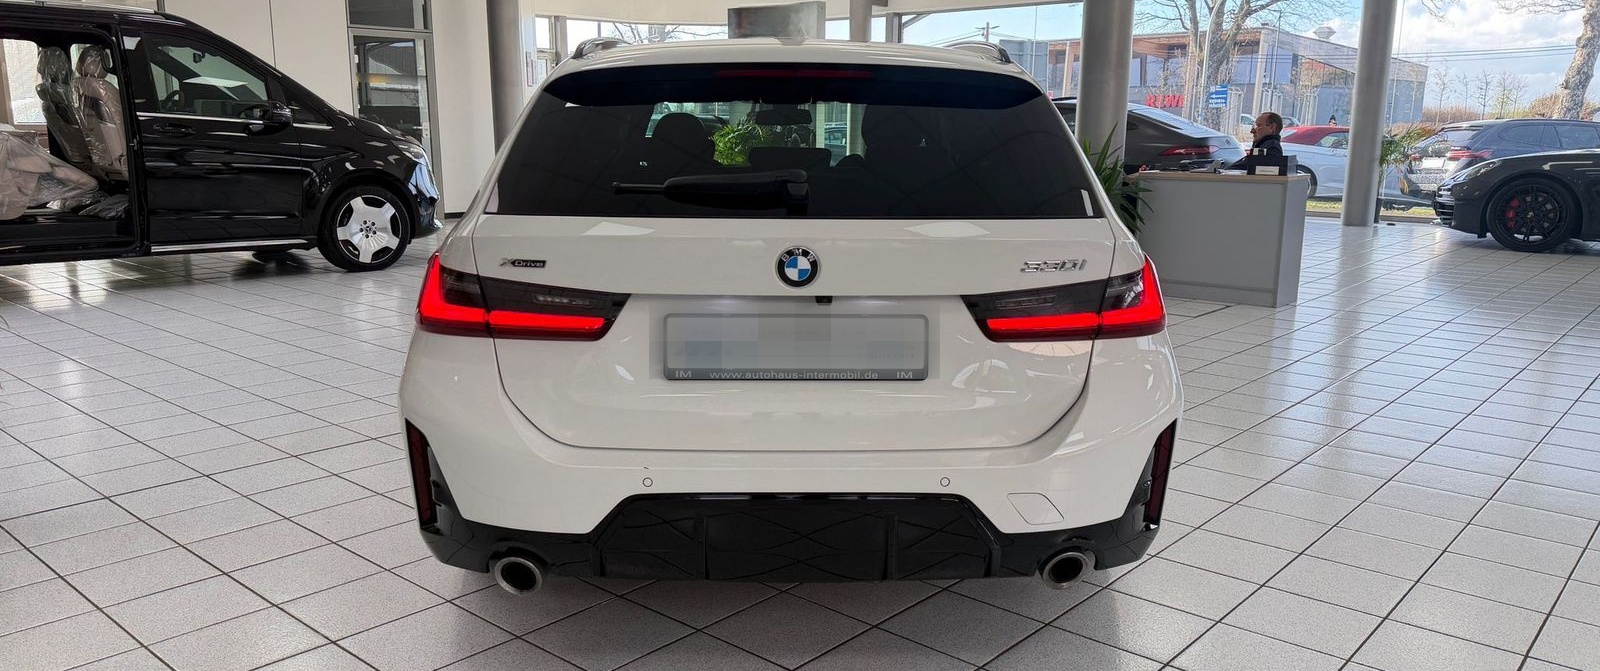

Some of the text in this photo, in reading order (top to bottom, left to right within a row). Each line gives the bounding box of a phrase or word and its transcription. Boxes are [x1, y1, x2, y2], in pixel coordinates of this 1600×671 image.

[780, 248, 816, 262] BMW
[1020, 259, 1087, 273] 330i
[675, 370, 913, 379] IM www.autohaus-intermobil.de IM
